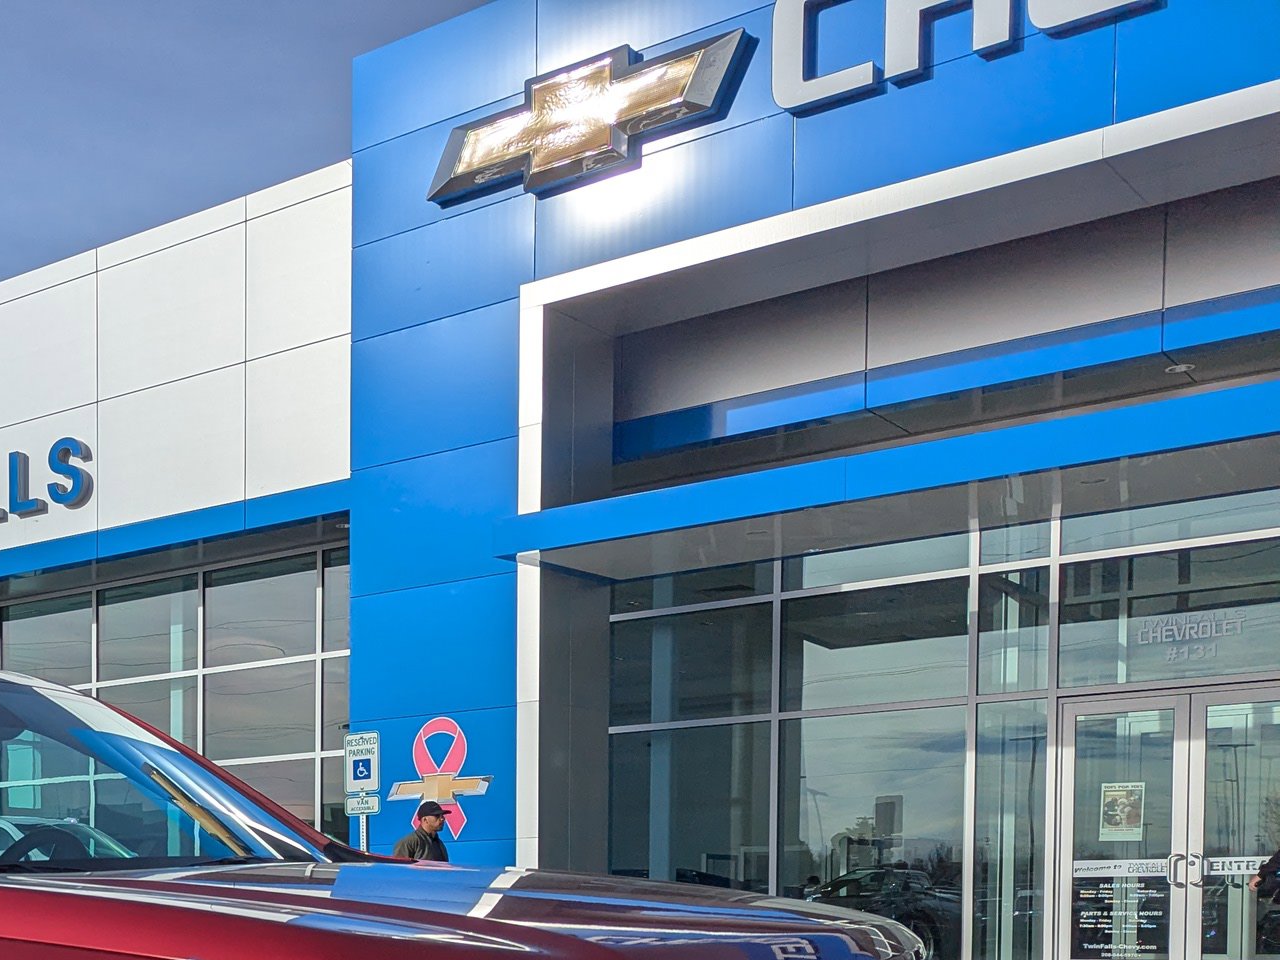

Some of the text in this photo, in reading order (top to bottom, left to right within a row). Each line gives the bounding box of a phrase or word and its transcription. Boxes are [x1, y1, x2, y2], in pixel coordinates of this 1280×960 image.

[1137, 618, 1247, 645] CHEVROLET
[1167, 643, 1218, 663] #131
[347, 736, 377, 748] RESERVED
[349, 747, 375, 758] PARKING
[1074, 865, 1111, 873] Welcome
